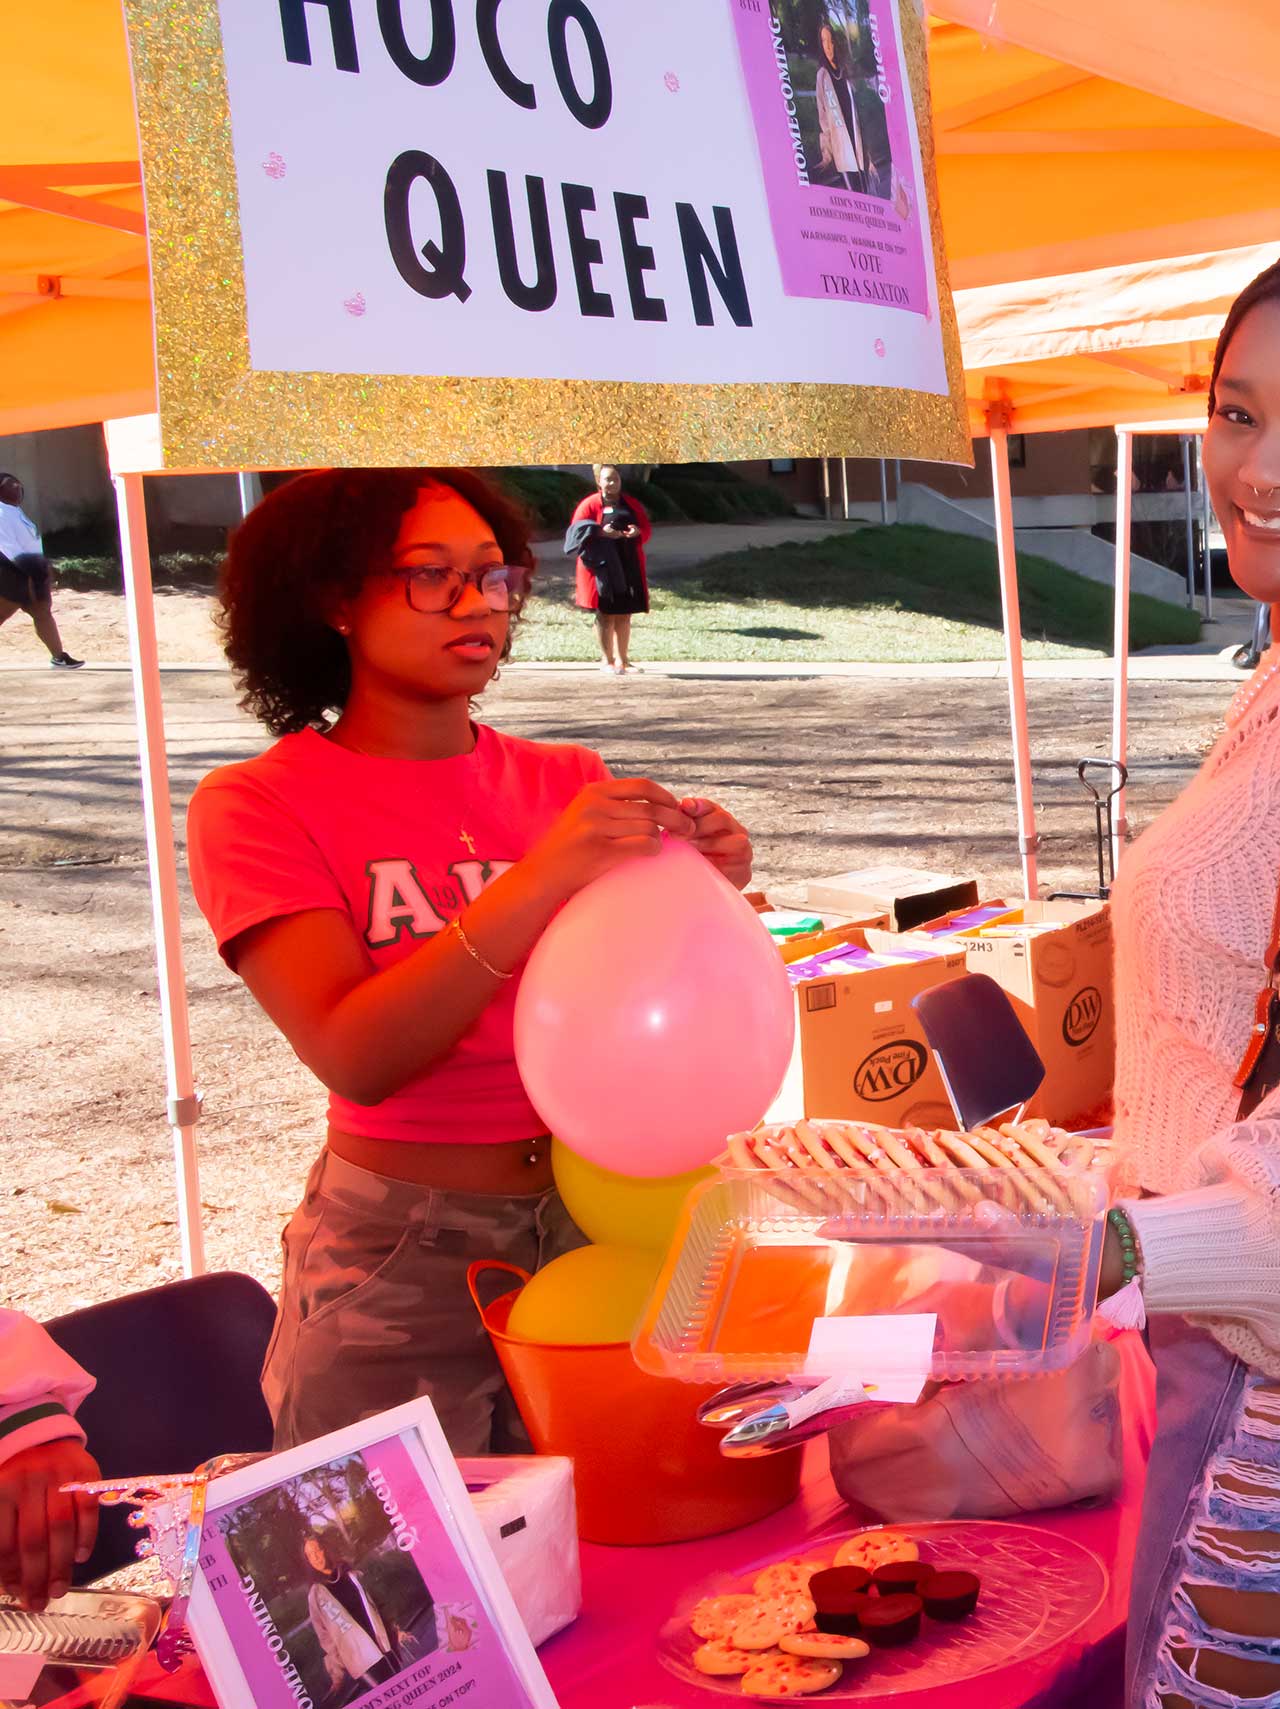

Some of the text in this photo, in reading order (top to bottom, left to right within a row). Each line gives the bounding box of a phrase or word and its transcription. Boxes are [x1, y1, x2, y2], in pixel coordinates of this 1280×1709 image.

[278, 0, 612, 130] HOCO
[869, 14, 892, 104] Queen
[768, 17, 811, 187] HOMECOMING
[809, 206, 864, 225] HOMECOMING
[864, 215, 886, 229] QUEEN
[853, 200, 871, 213] NEXT
[383, 149, 753, 328] QUEEN
[851, 235, 876, 250] WANNA
[848, 250, 883, 274] VOTE
[820, 273, 910, 305] TYRA SAXTON
[1069, 995, 1098, 1030] DW
[859, 1056, 917, 1096] DW
[368, 1467, 420, 1551] Queen
[200, 1554, 216, 1569] EB
[209, 1574, 228, 1591] TH
[238, 1574, 314, 1709] OMECOMING
[384, 1680, 411, 1700] NEXT
[412, 1664, 432, 1683] TOP
[402, 1678, 438, 1707] QUEEN
[438, 1661, 463, 1682] 2024
[439, 1679, 476, 1708] ON TOP?
